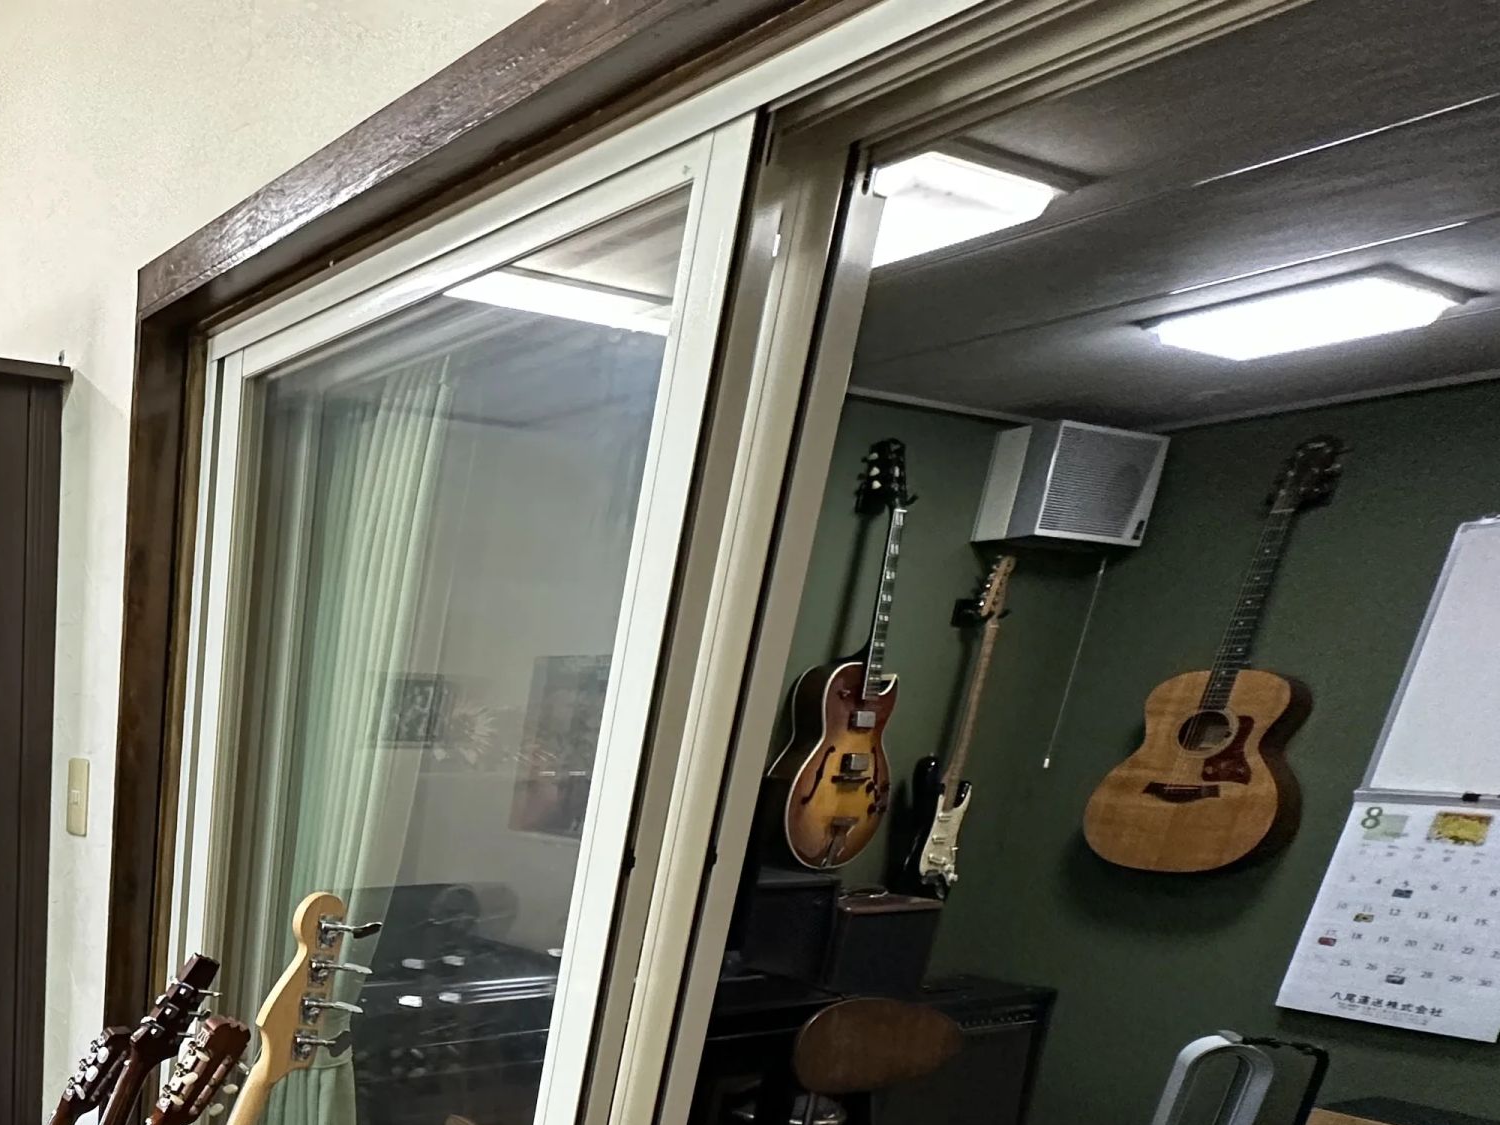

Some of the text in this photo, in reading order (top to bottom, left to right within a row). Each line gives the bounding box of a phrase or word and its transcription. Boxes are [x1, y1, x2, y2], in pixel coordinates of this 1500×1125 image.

[1361, 806, 1383, 829] 8
[1389, 908, 1401, 916] 12
[1417, 911, 1429, 920] 13
[1445, 915, 1458, 923] 14
[1351, 932, 1363, 940] 18
[1378, 935, 1389, 944] 19
[1405, 939, 1417, 947] 20
[1433, 942, 1444, 951] 21
[1461, 946, 1474, 955] 22
[1340, 959, 1350, 967] 25
[1365, 963, 1378, 971] 26
[1421, 970, 1433, 979] 28
[1449, 974, 1463, 983] 29
[1479, 979, 1493, 988] 30
[1330, 992, 1443, 1018] 八尾運送株式会社
